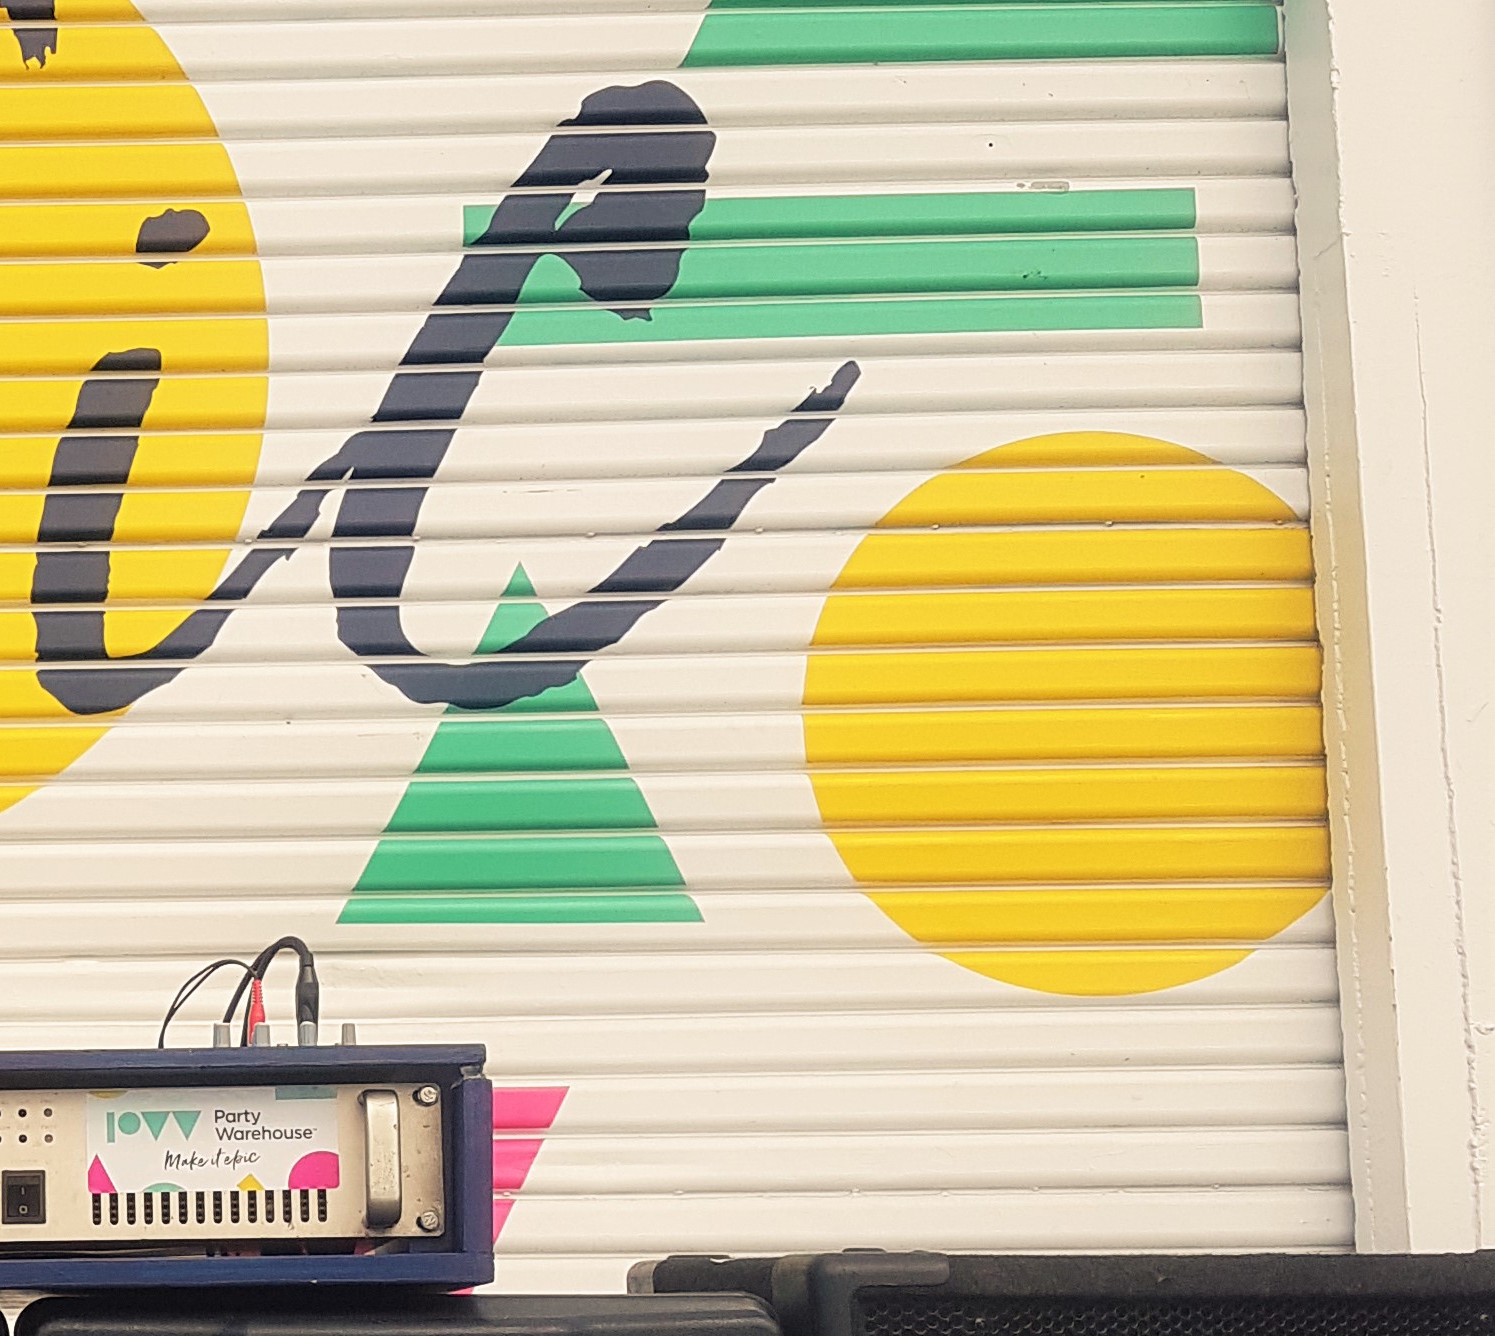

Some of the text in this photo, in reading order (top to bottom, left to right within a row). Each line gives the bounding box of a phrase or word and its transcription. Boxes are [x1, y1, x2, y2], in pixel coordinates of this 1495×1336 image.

[214, 1109, 261, 1125] Party
[164, 1150, 208, 1170] Make
[224, 1149, 261, 1170] epic
